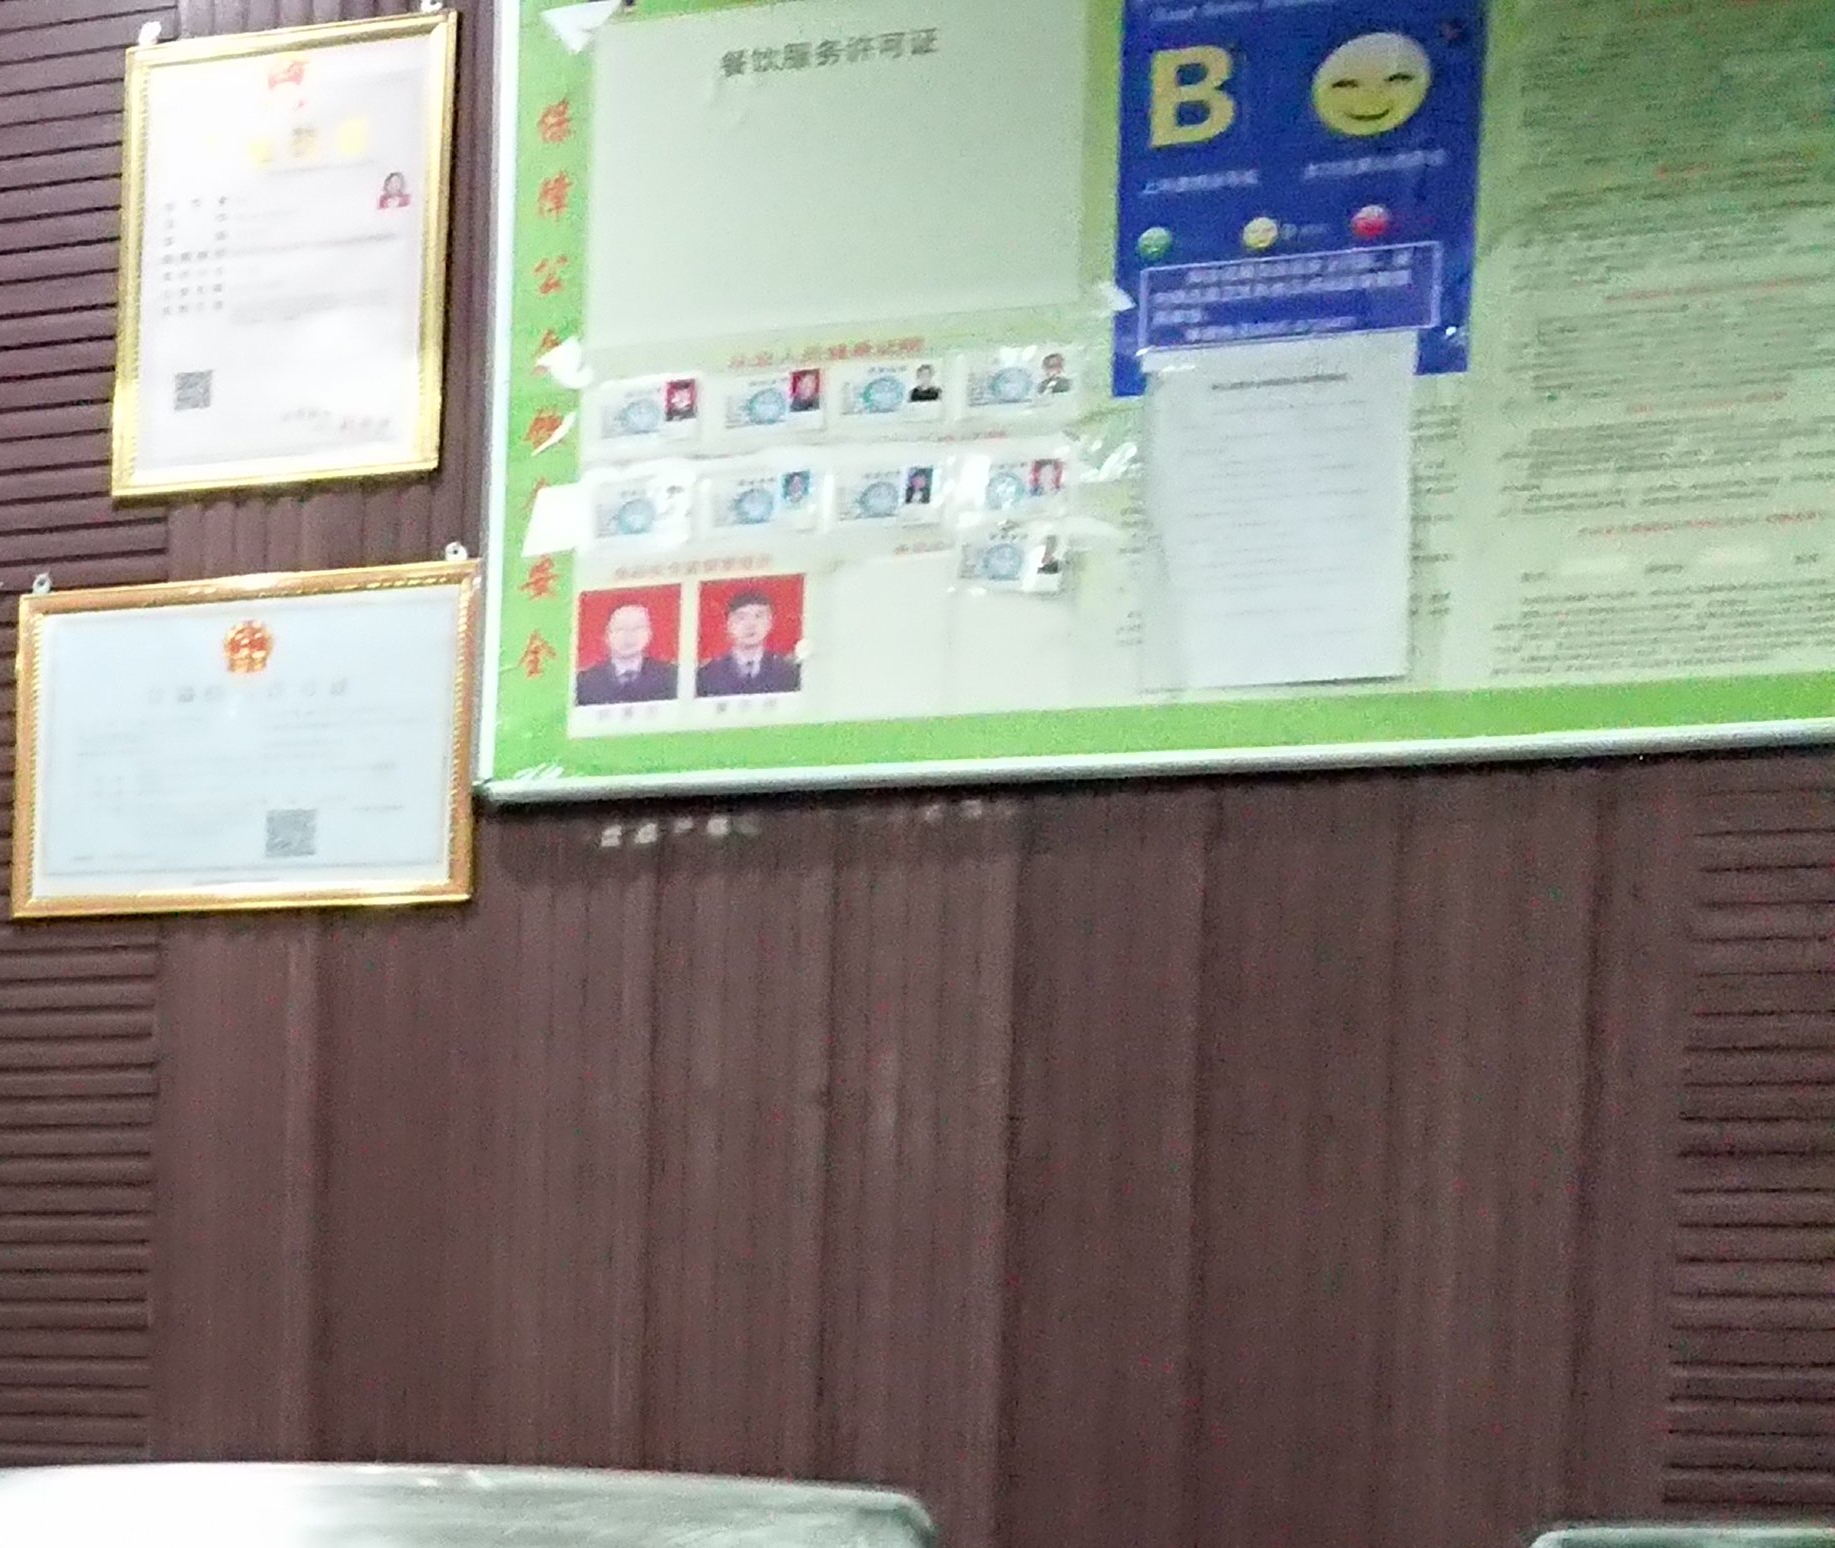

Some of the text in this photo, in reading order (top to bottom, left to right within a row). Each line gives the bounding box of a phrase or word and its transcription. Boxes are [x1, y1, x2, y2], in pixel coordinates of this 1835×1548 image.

[720, 28, 939, 77] 餐饮服务许可证
[1148, 44, 1237, 149] B
